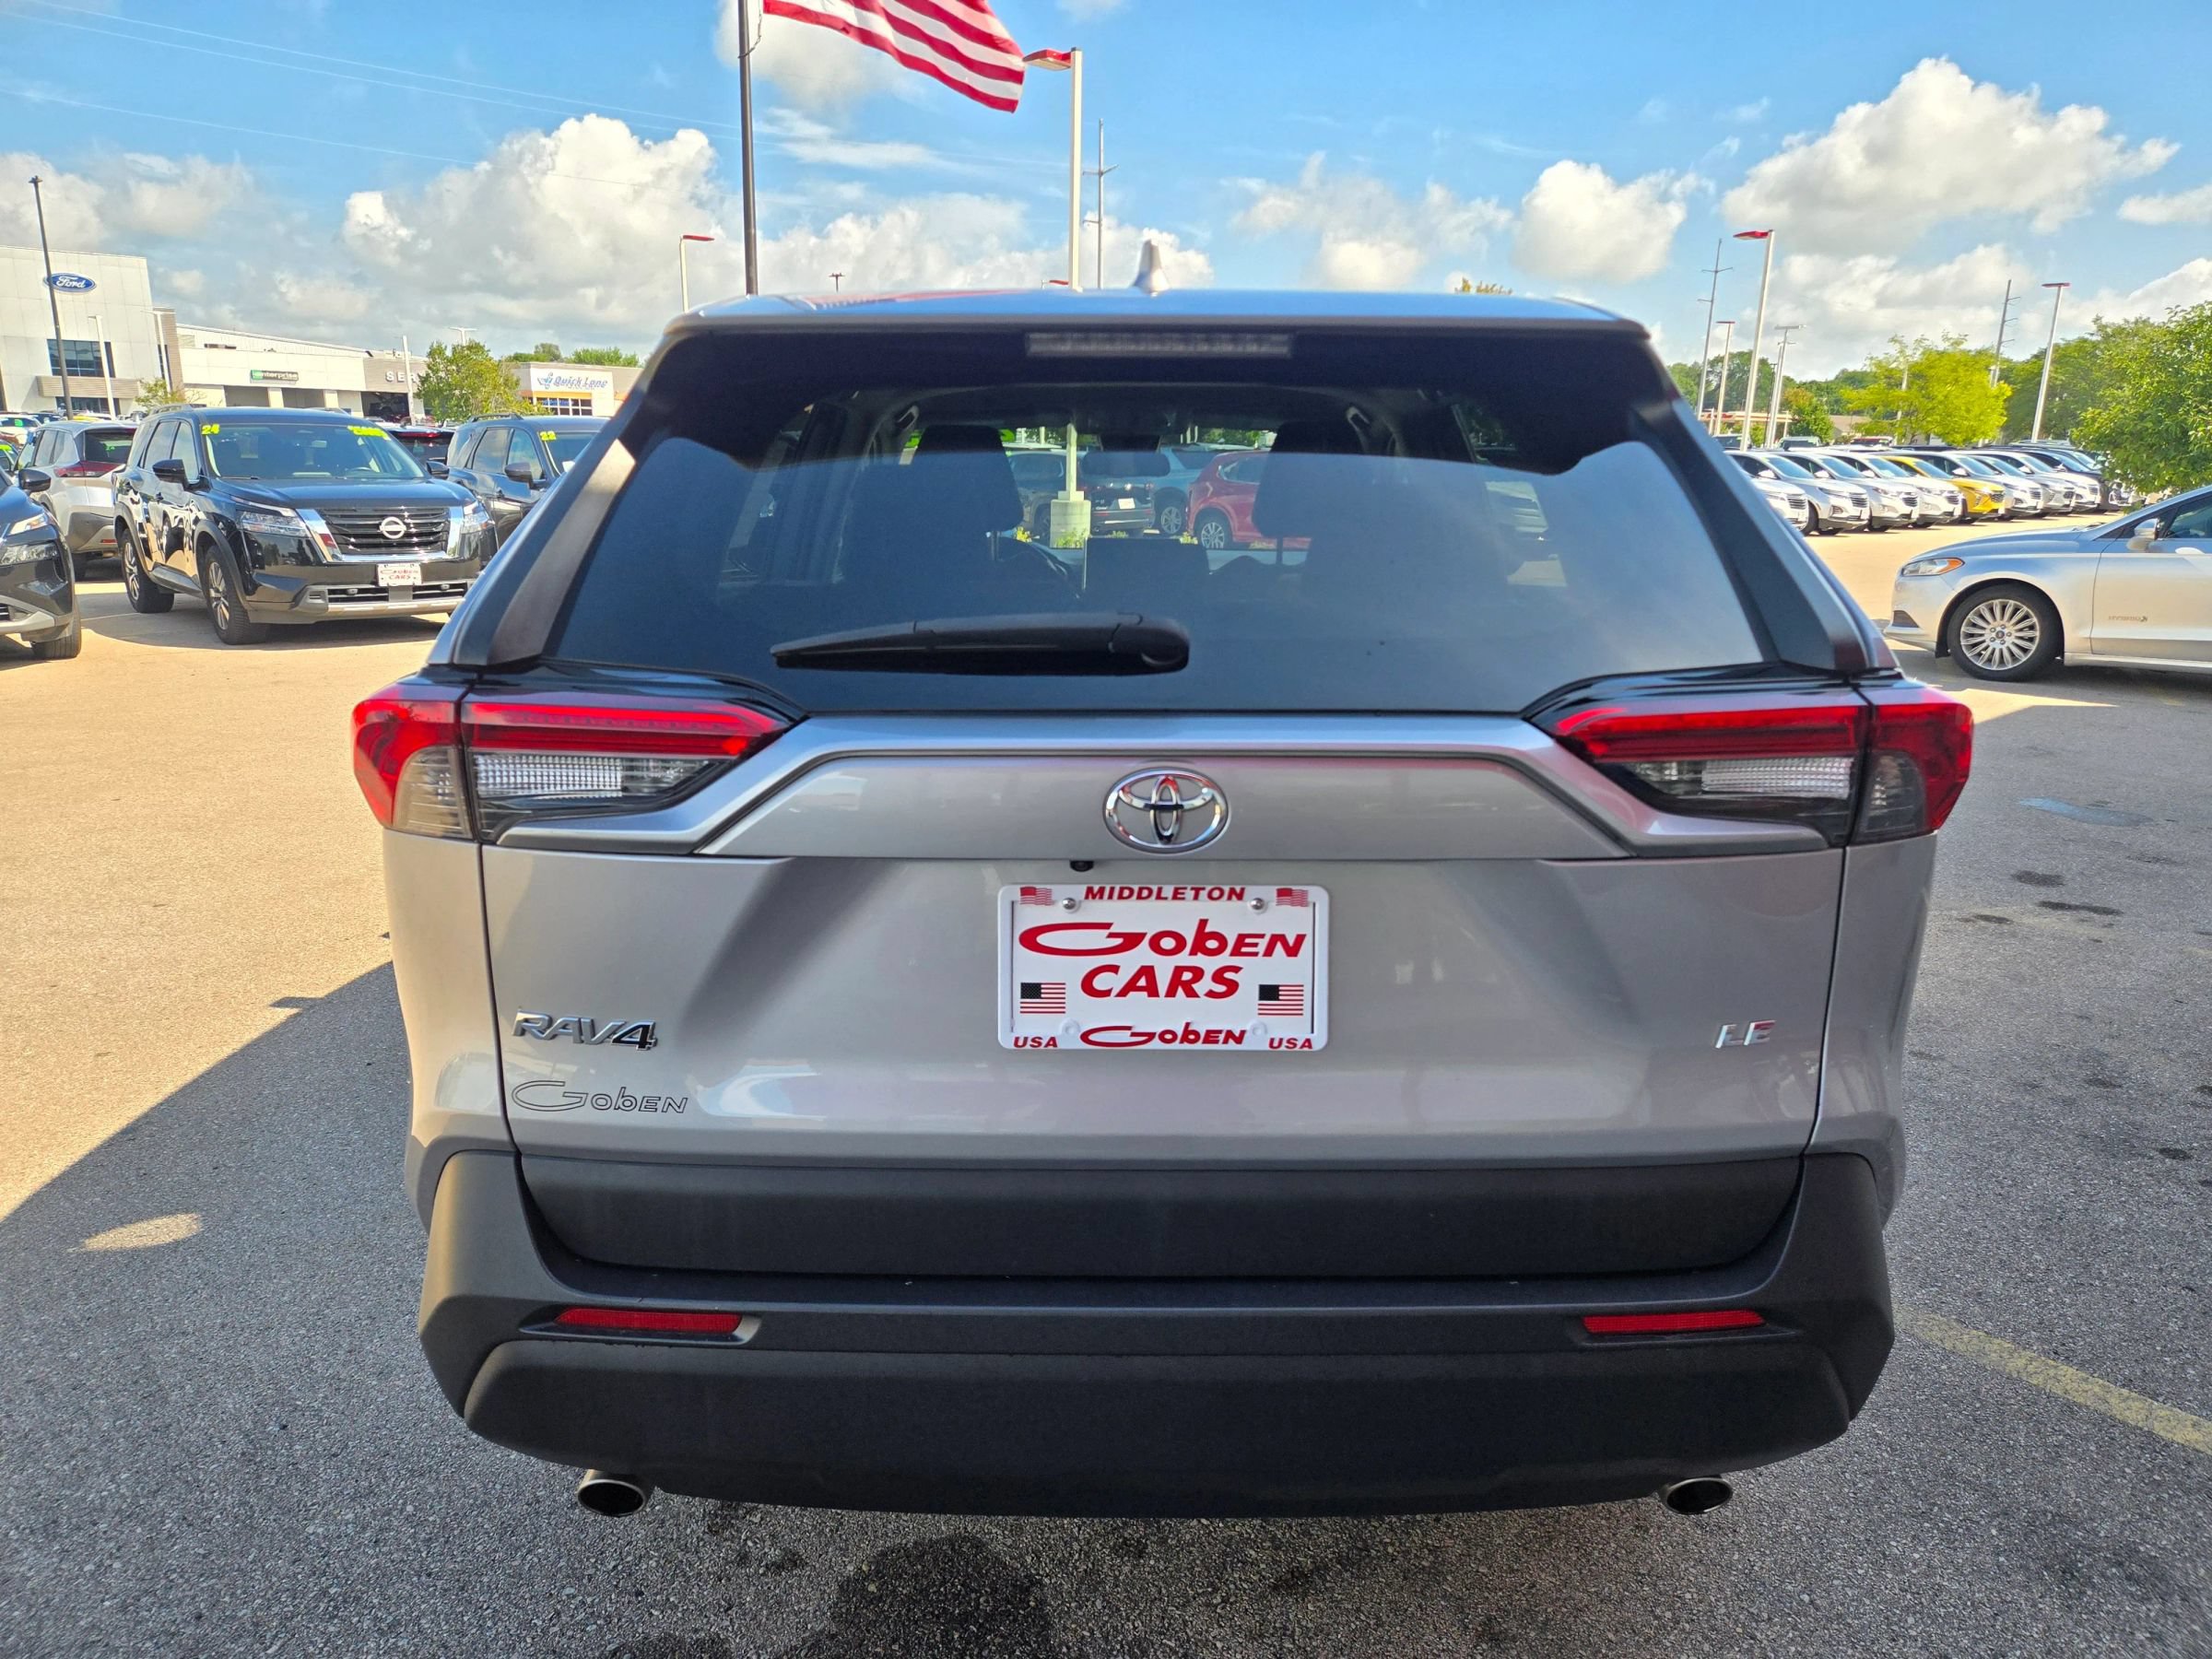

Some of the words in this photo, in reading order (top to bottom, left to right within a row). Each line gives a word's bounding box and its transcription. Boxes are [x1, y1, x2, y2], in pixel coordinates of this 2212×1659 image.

[56, 276, 87, 288] Ford
[554, 375, 582, 386] Quick
[584, 376, 608, 388] Lane
[1083, 886, 1246, 901] MIDDLETON
[1080, 964, 1243, 999] CARS
[512, 1009, 658, 1051] RAV4
[1714, 1019, 1777, 1049] LE
[1014, 1036, 1058, 1049] USA
[1268, 1037, 1313, 1050] USA
